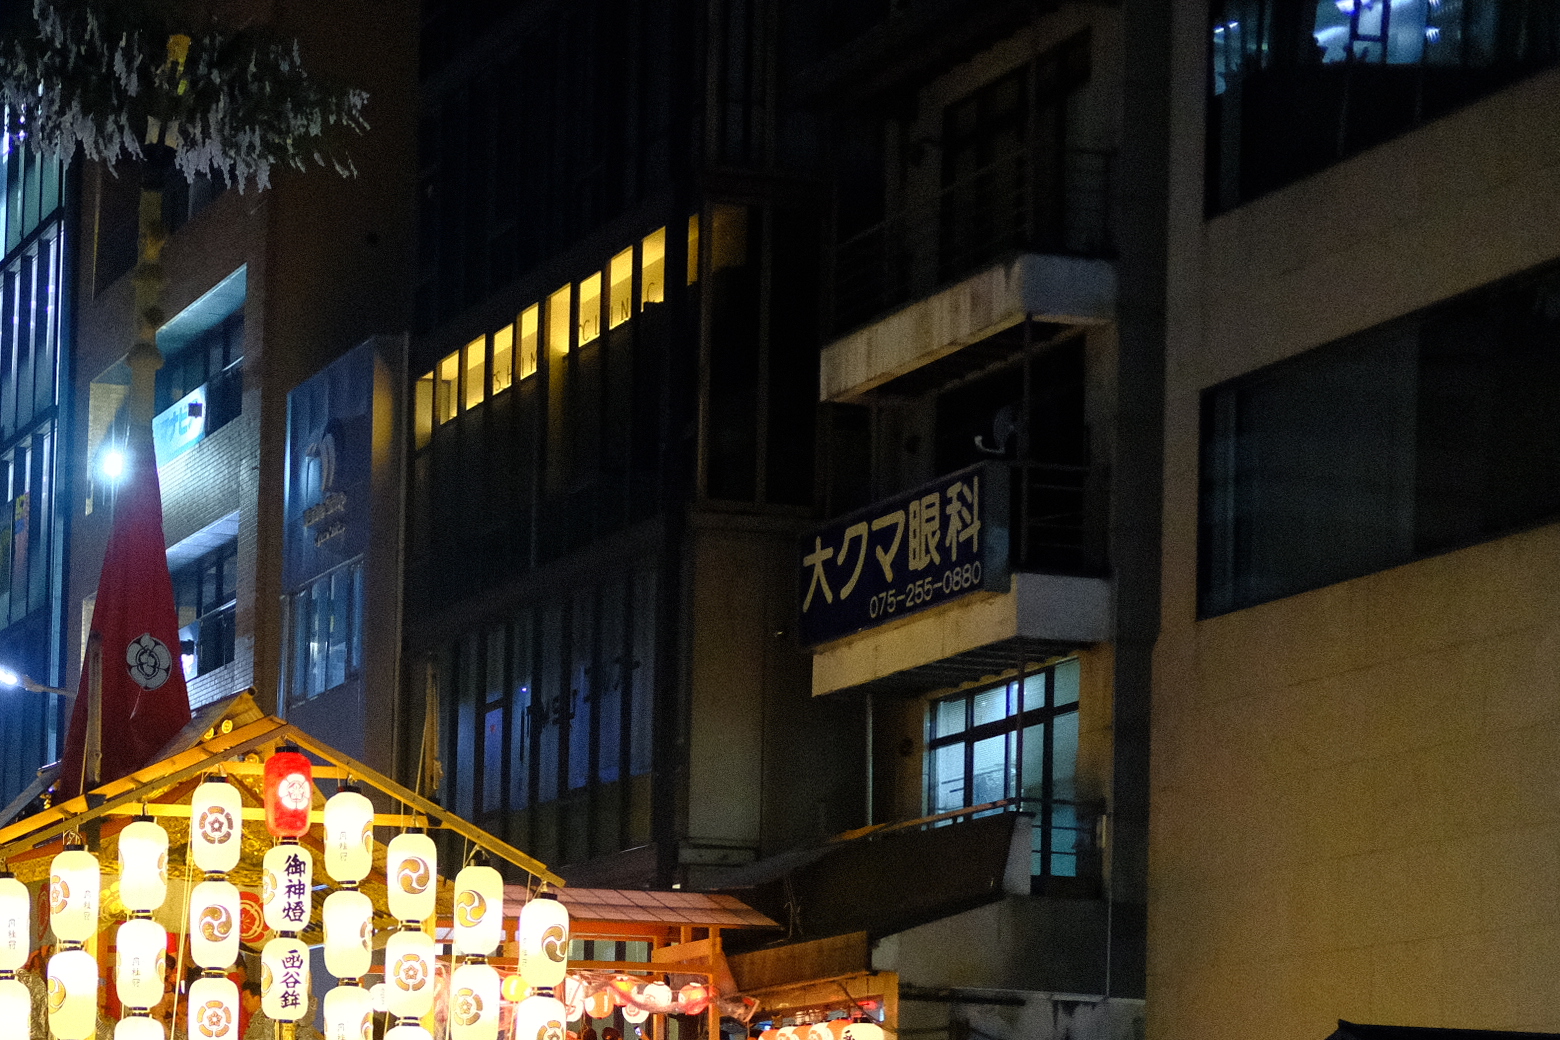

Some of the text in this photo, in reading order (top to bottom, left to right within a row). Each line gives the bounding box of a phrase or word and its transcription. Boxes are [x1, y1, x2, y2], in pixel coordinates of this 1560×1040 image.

[581, 283, 655, 343] CLINC
[803, 475, 981, 613] 大クマ眼科
[869, 560, 982, 618] 075-255-0880
[282, 853, 306, 923] 御神燈
[279, 949, 304, 1009] 函谷鉾
